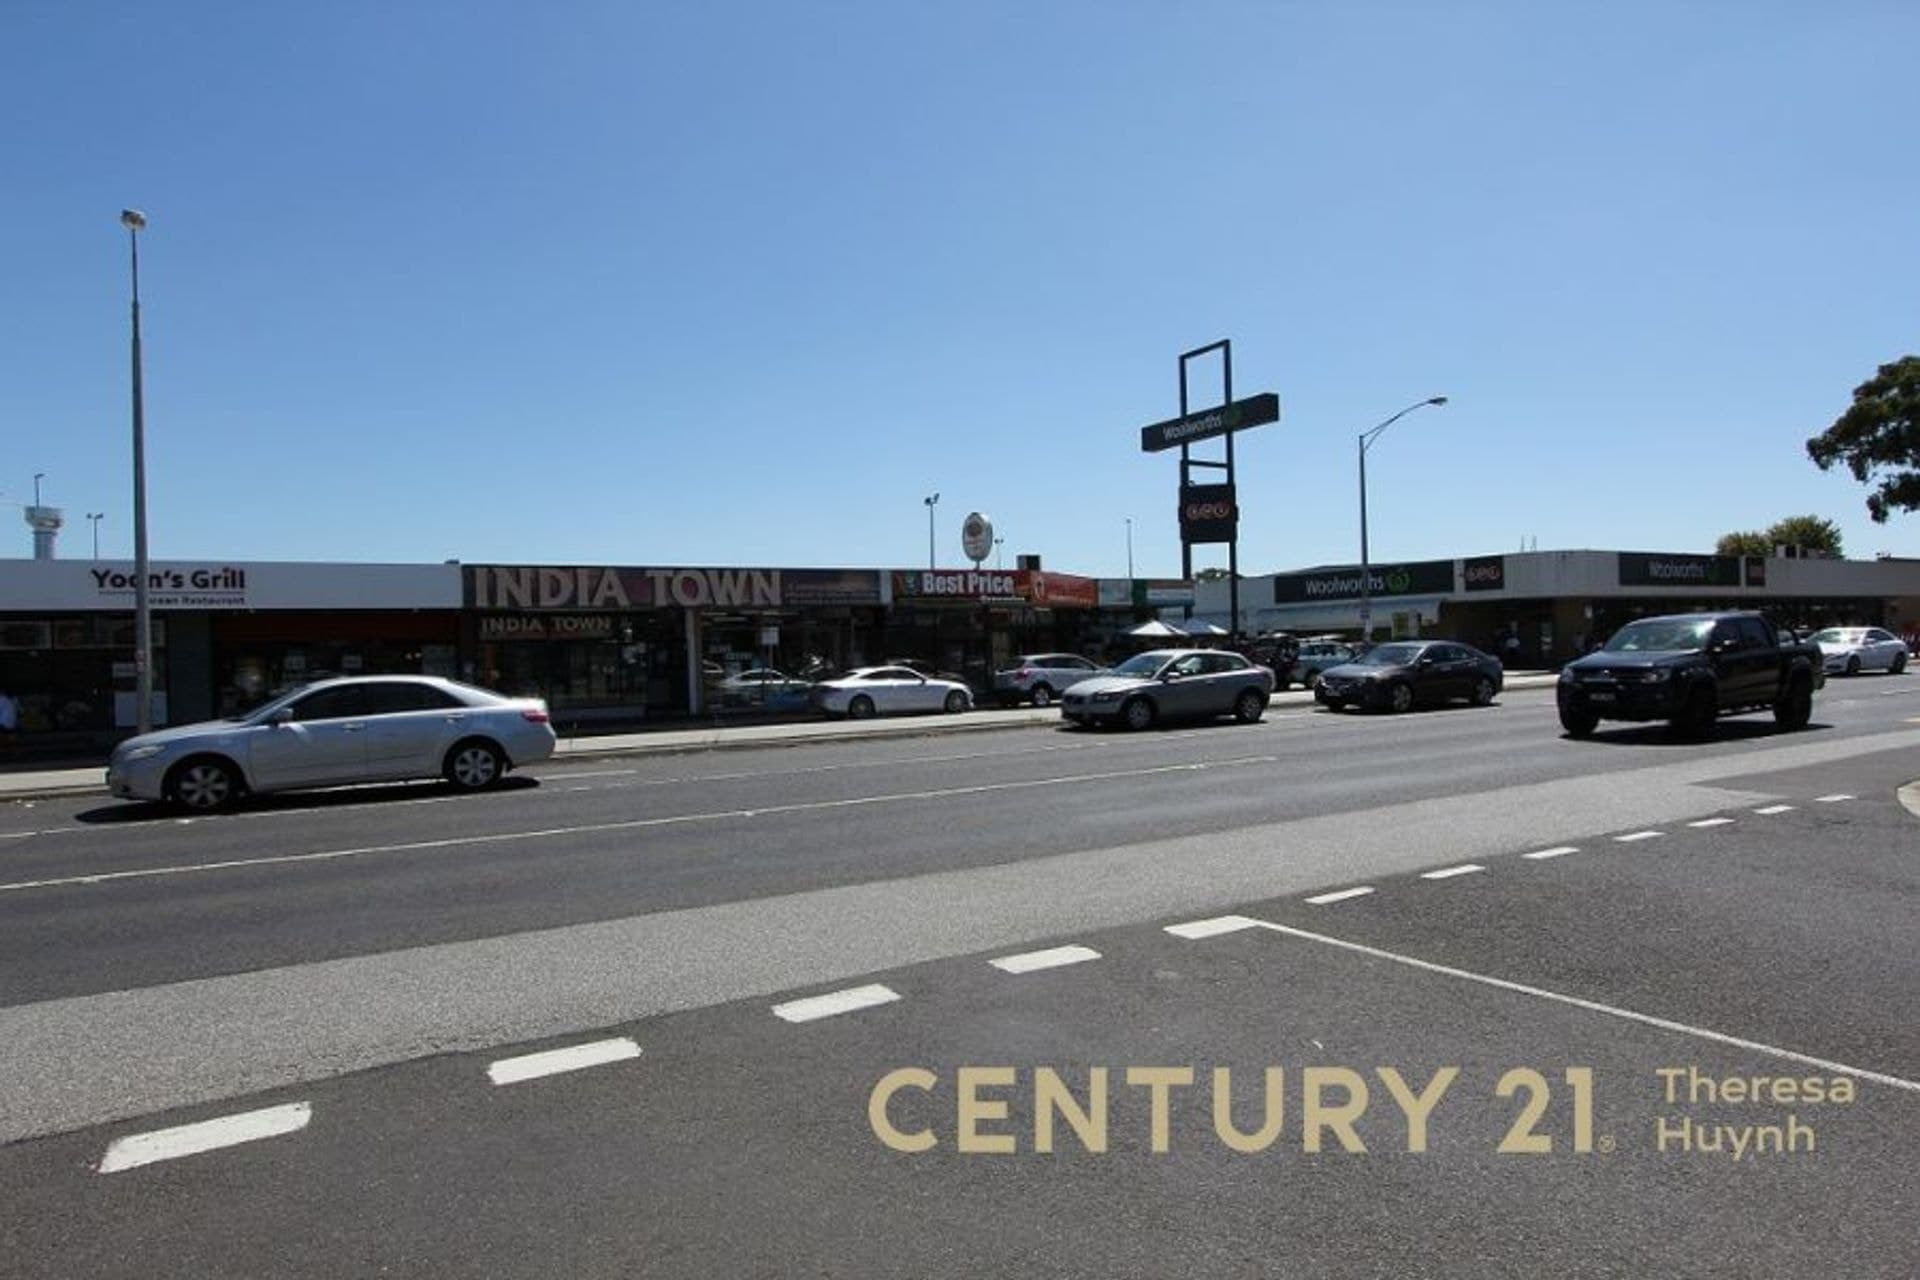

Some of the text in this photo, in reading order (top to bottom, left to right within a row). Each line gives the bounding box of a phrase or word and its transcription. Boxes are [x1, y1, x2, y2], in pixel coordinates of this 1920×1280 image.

[190, 567, 245, 588] Grill
[475, 567, 630, 607] INDIA
[645, 569, 781, 606] TOWN
[922, 572, 966, 594] Best
[967, 572, 1015, 594] Price
[1305, 572, 1385, 596] Woolworhs
[480, 615, 612, 633] INDIA TOWN
